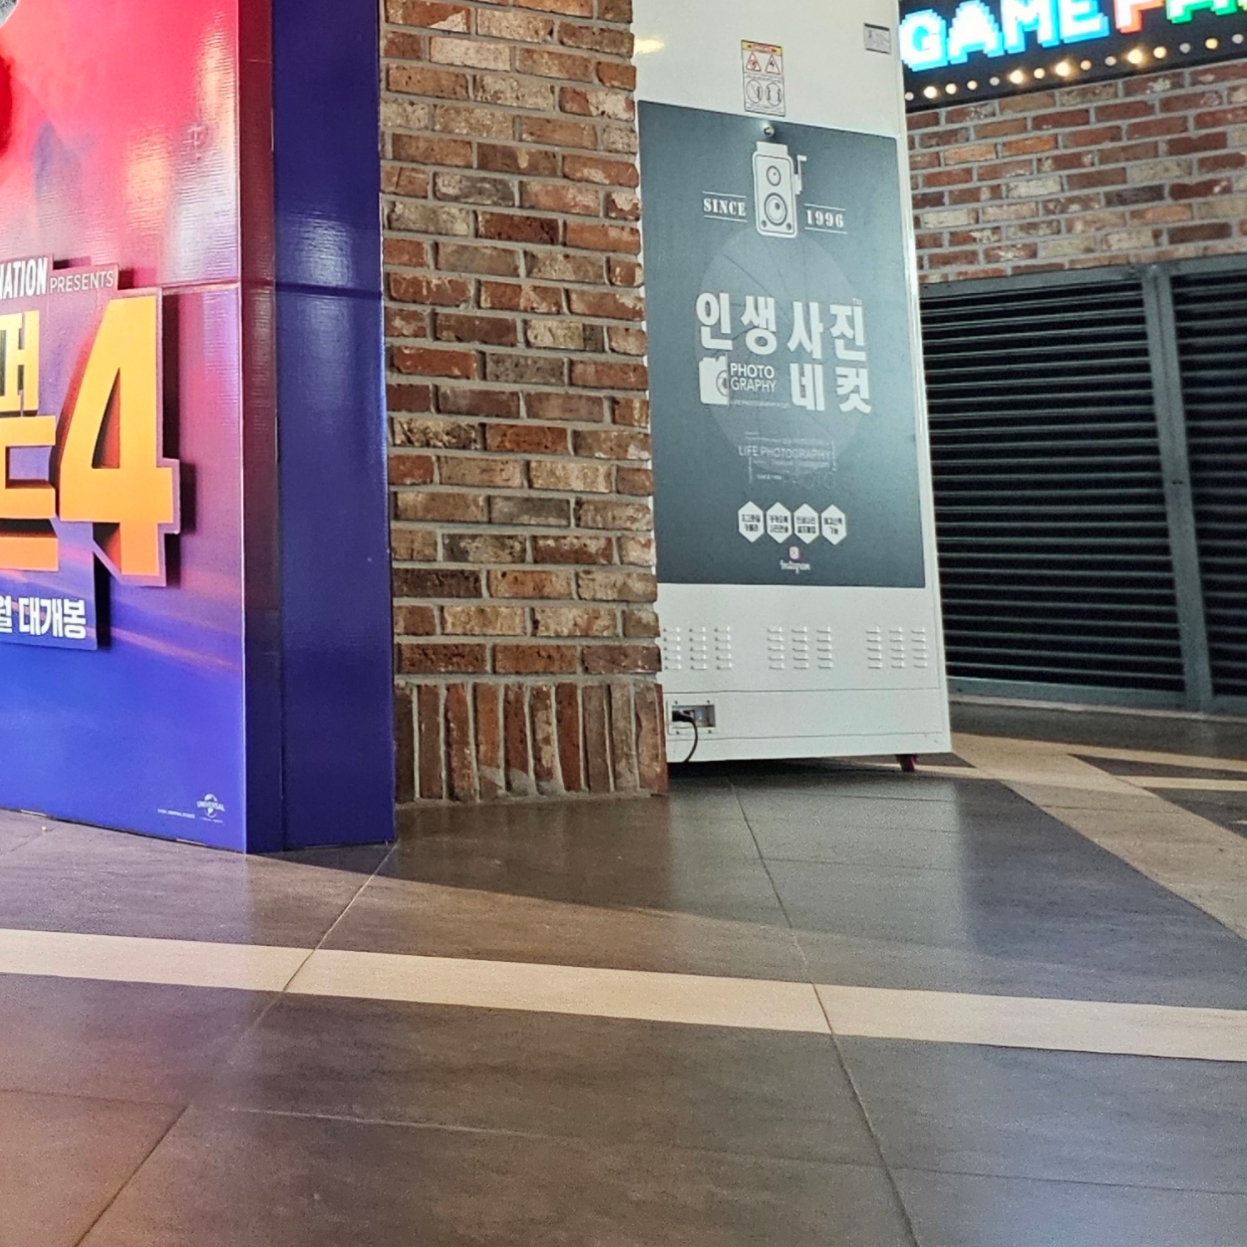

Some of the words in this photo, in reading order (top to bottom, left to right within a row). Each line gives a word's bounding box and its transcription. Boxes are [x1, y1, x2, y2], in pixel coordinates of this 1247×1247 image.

[702, 198, 747, 218] SINCE
[806, 208, 846, 230] 1996
[50, 269, 115, 295] PRESENTS
[695, 291, 868, 362] 인생사진
[729, 362, 775, 380] PHOTO
[729, 377, 777, 393] GRAPHY
[789, 362, 872, 415] 네컷
[59, 294, 175, 577] 4
[738, 445, 758, 457] LIFE
[18, 596, 87, 640] 대개봉
